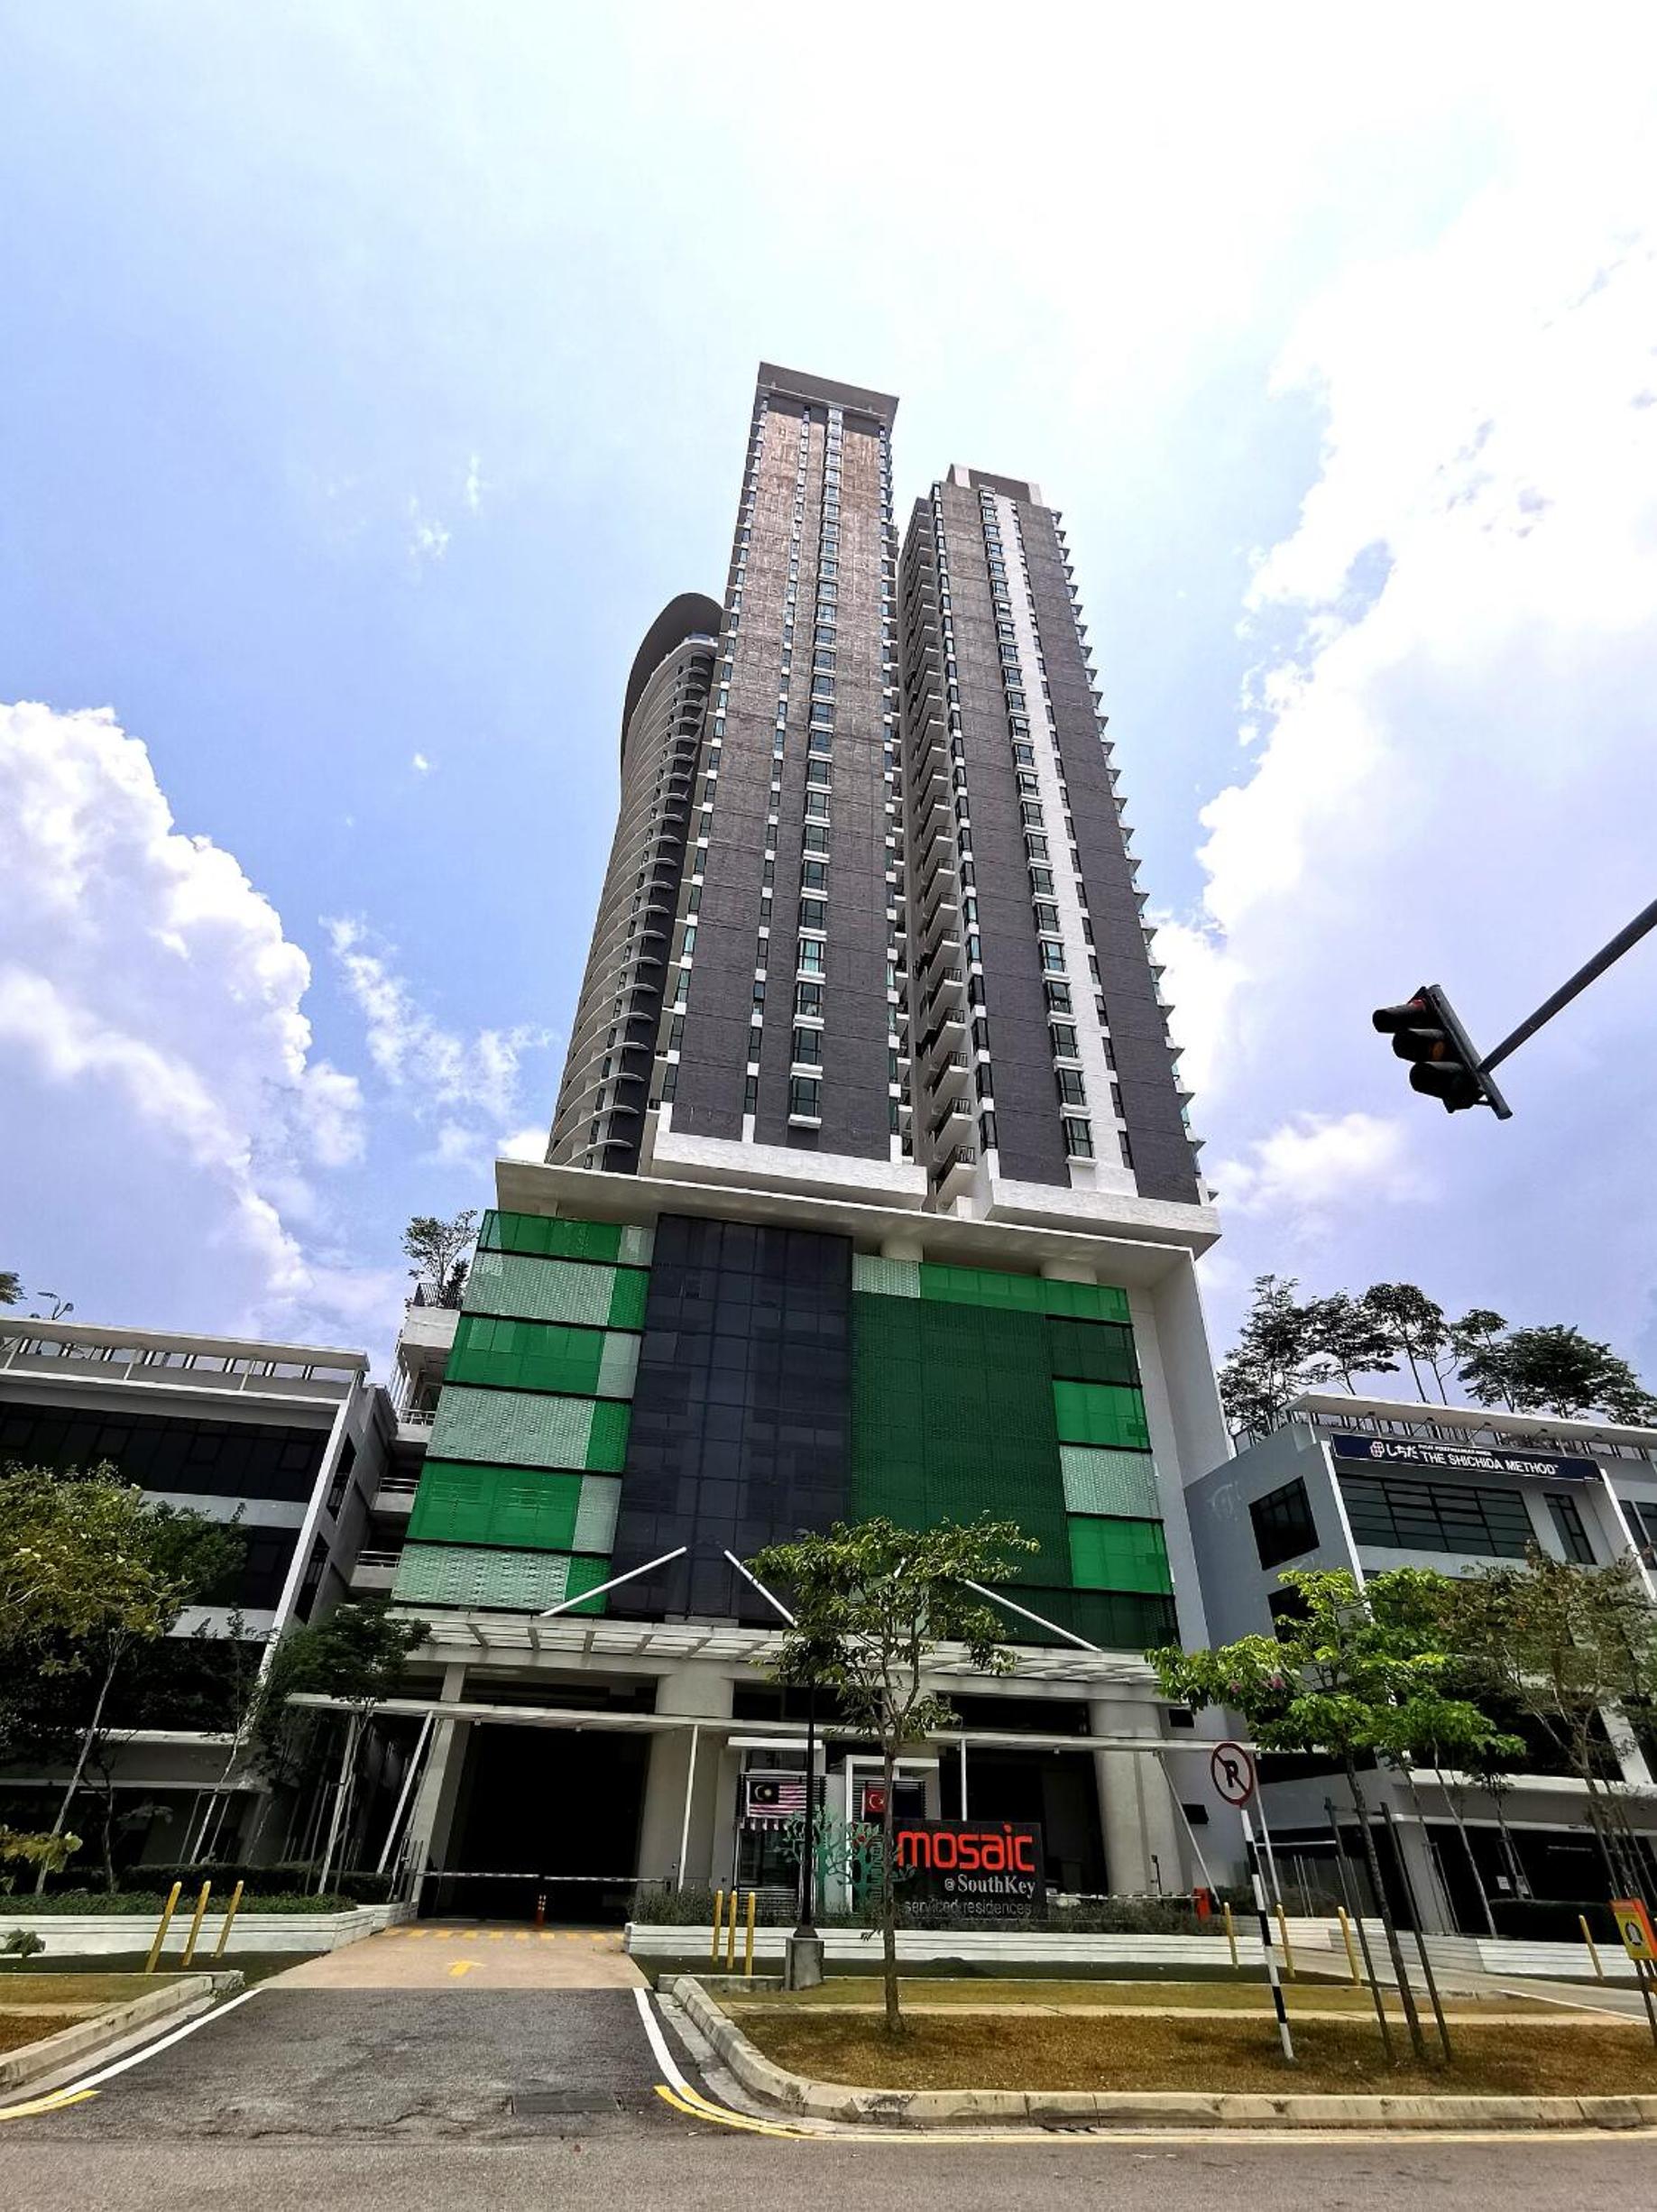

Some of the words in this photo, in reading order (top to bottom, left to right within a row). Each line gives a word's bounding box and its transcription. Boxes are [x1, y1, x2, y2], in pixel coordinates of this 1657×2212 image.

[1419, 1451, 1447, 1465] THE
[1447, 1453, 1504, 1470] SHICHIDA
[898, 1823, 1036, 1872] mosaic
[962, 1900, 1033, 1915] residences
